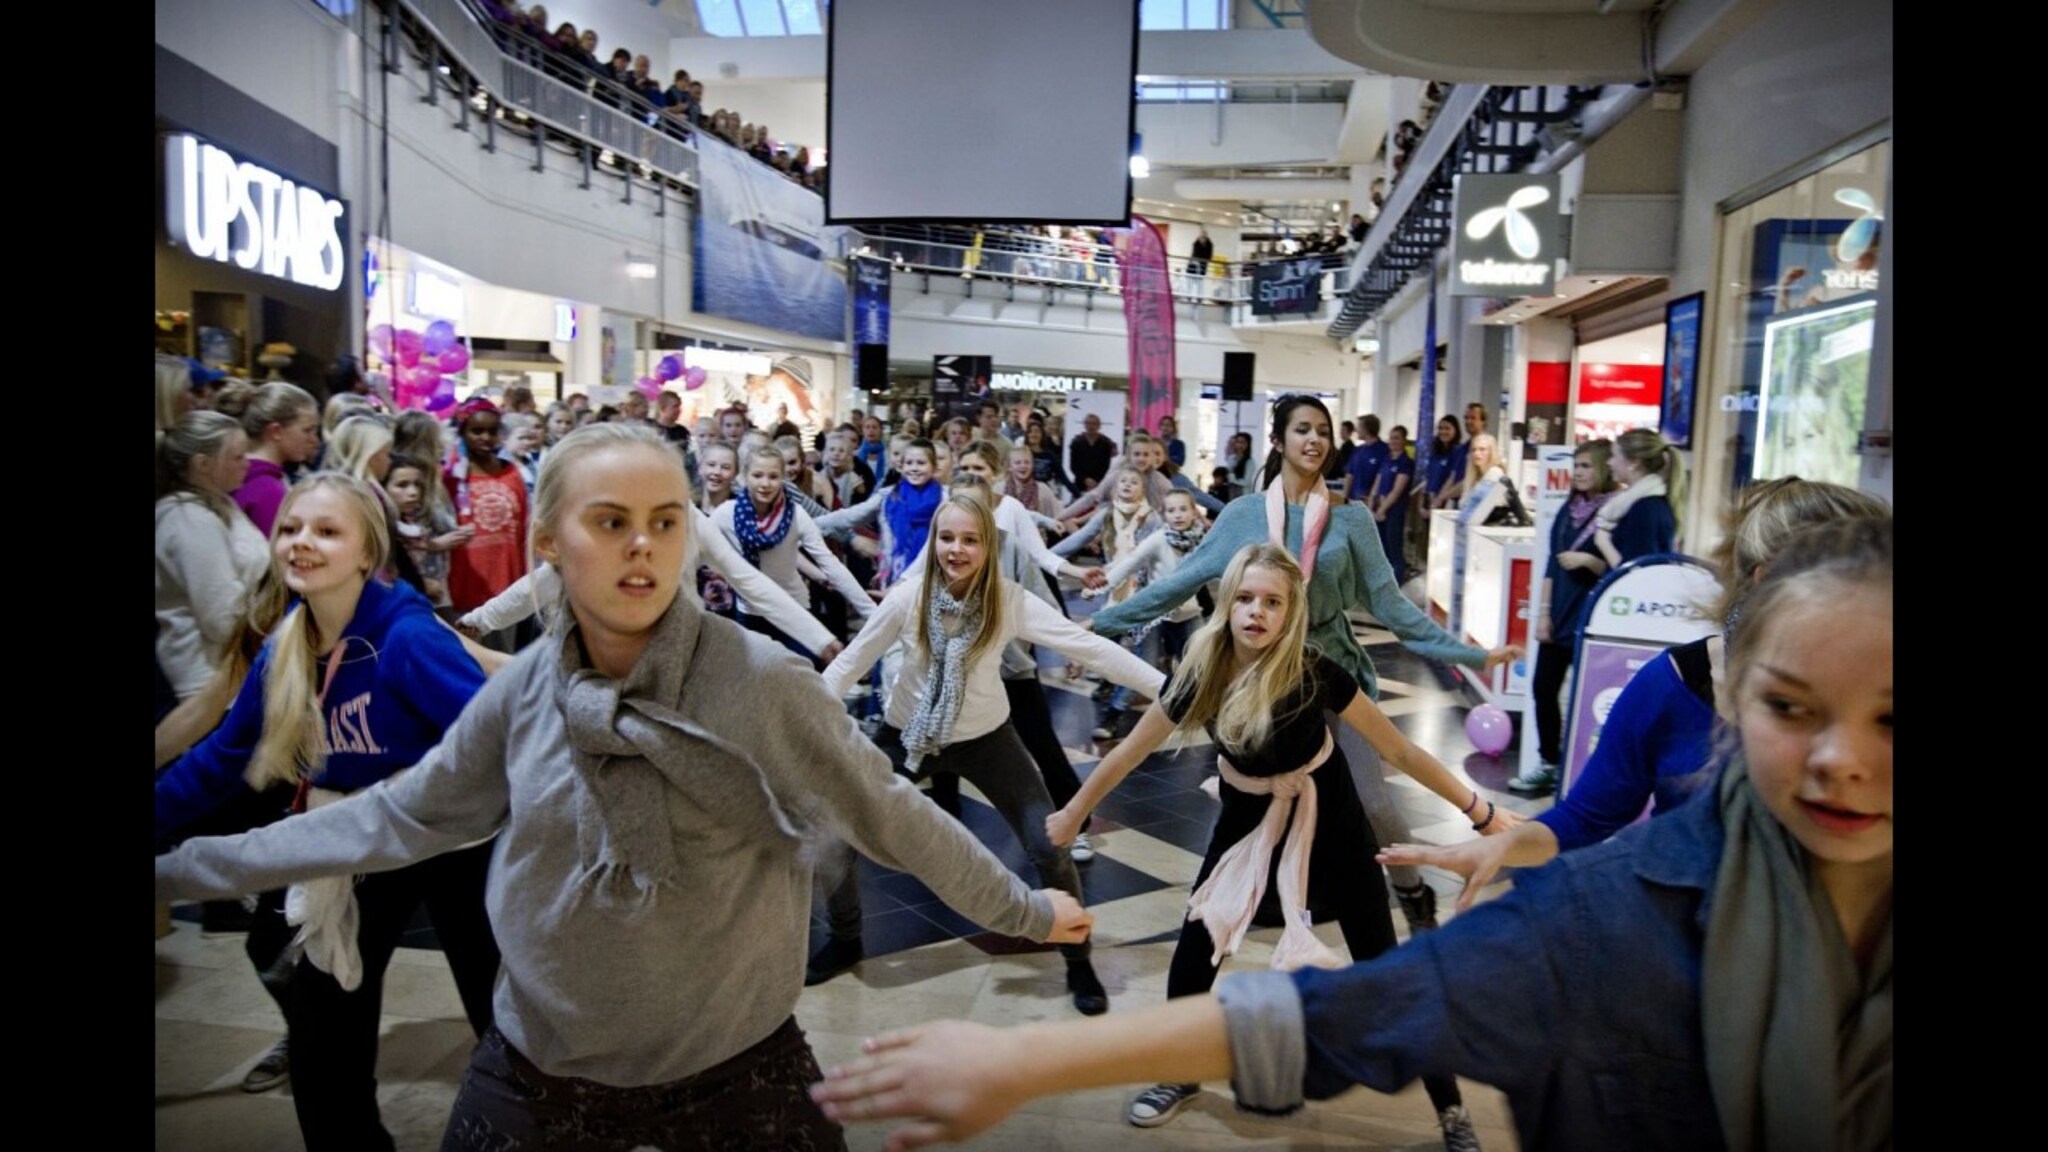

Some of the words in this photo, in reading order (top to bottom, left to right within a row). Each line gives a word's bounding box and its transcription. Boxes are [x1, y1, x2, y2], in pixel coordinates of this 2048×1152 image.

[1460, 258, 1550, 285] telenor
[1258, 280, 1307, 306] Spinn
[320, 692, 382, 755] AST
